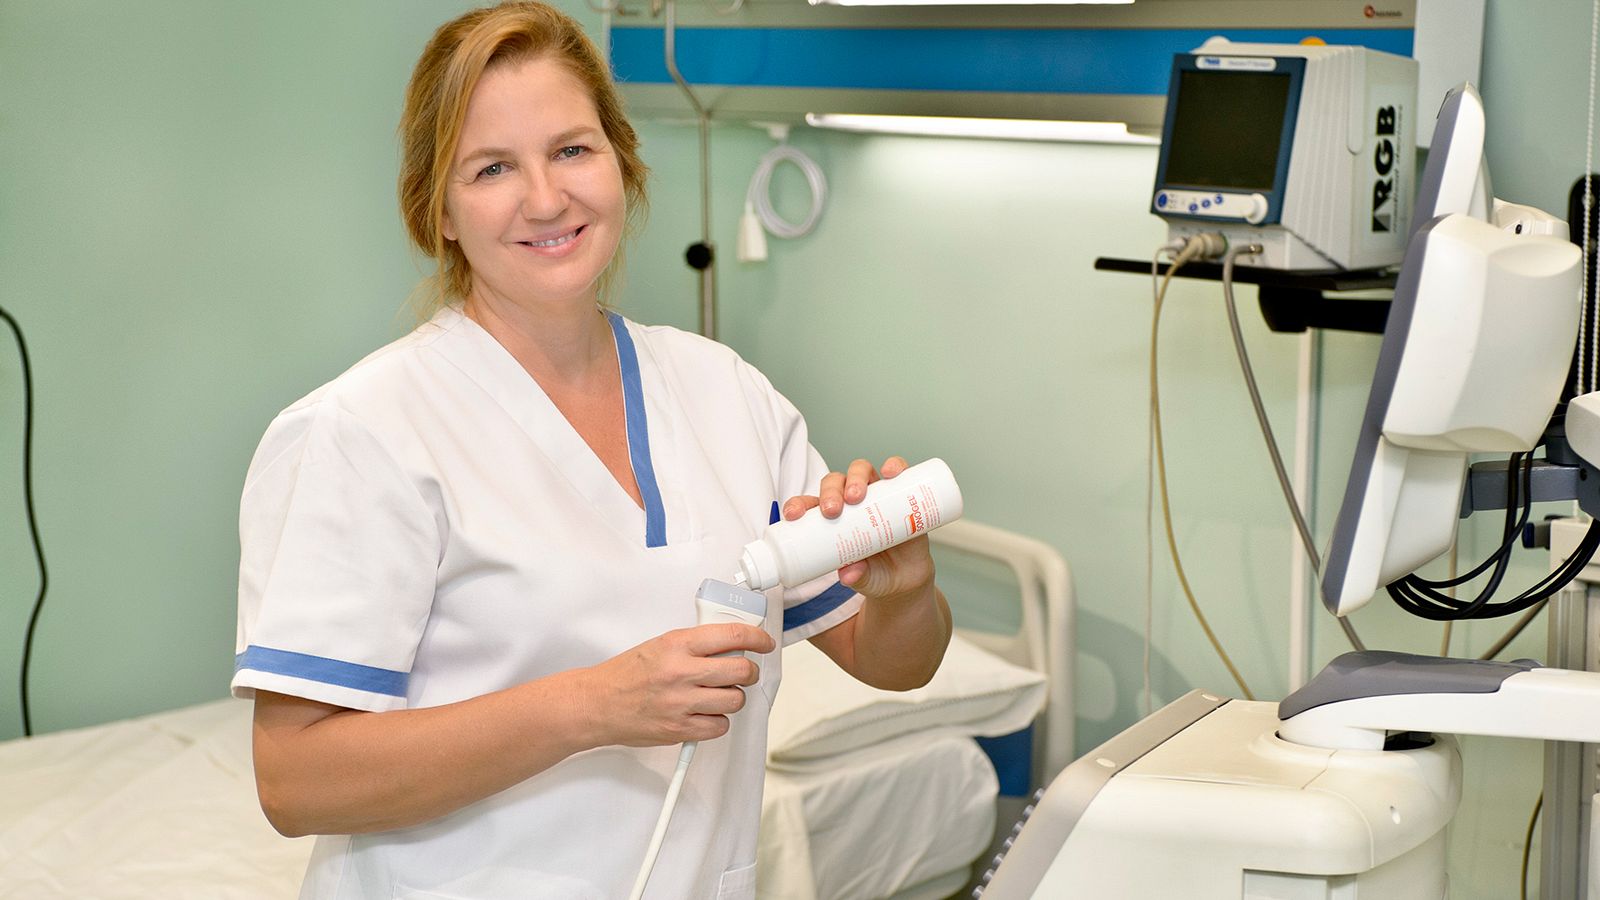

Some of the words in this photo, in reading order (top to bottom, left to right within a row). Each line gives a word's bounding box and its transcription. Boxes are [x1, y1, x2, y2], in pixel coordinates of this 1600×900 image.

[868, 513, 879, 528] 250
[908, 495, 924, 533] SONOGEL
[728, 592, 745, 606] 11L
